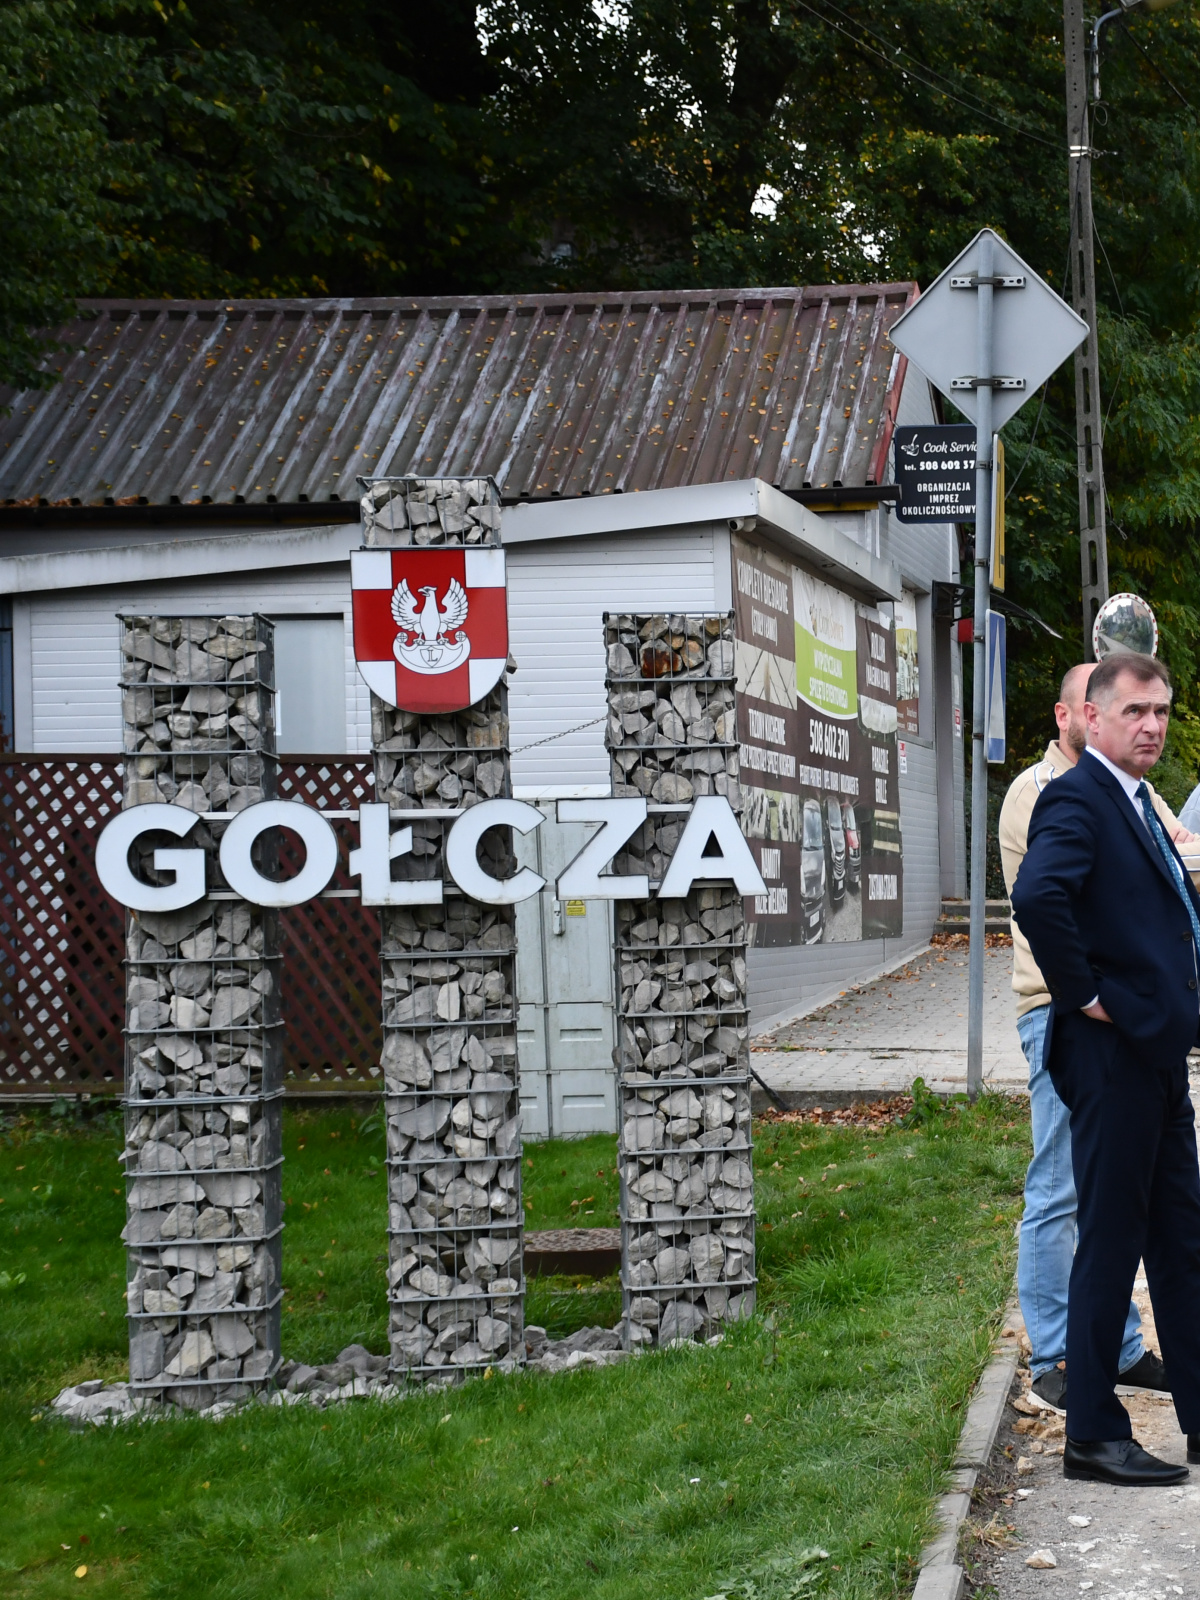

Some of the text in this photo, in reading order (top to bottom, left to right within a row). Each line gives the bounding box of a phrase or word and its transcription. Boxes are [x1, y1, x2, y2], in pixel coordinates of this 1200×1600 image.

[923, 440, 977, 453] Cook Servic
[904, 460, 976, 471] tel. 508 602 37
[917, 482, 971, 493] ORGANIZACJA
[929, 494, 960, 503] IMPREZ
[902, 503, 976, 516] OKOLICZNOŚCIOWY
[809, 718, 850, 762] 508 602 370
[95, 795, 768, 912] GOŁCZA
